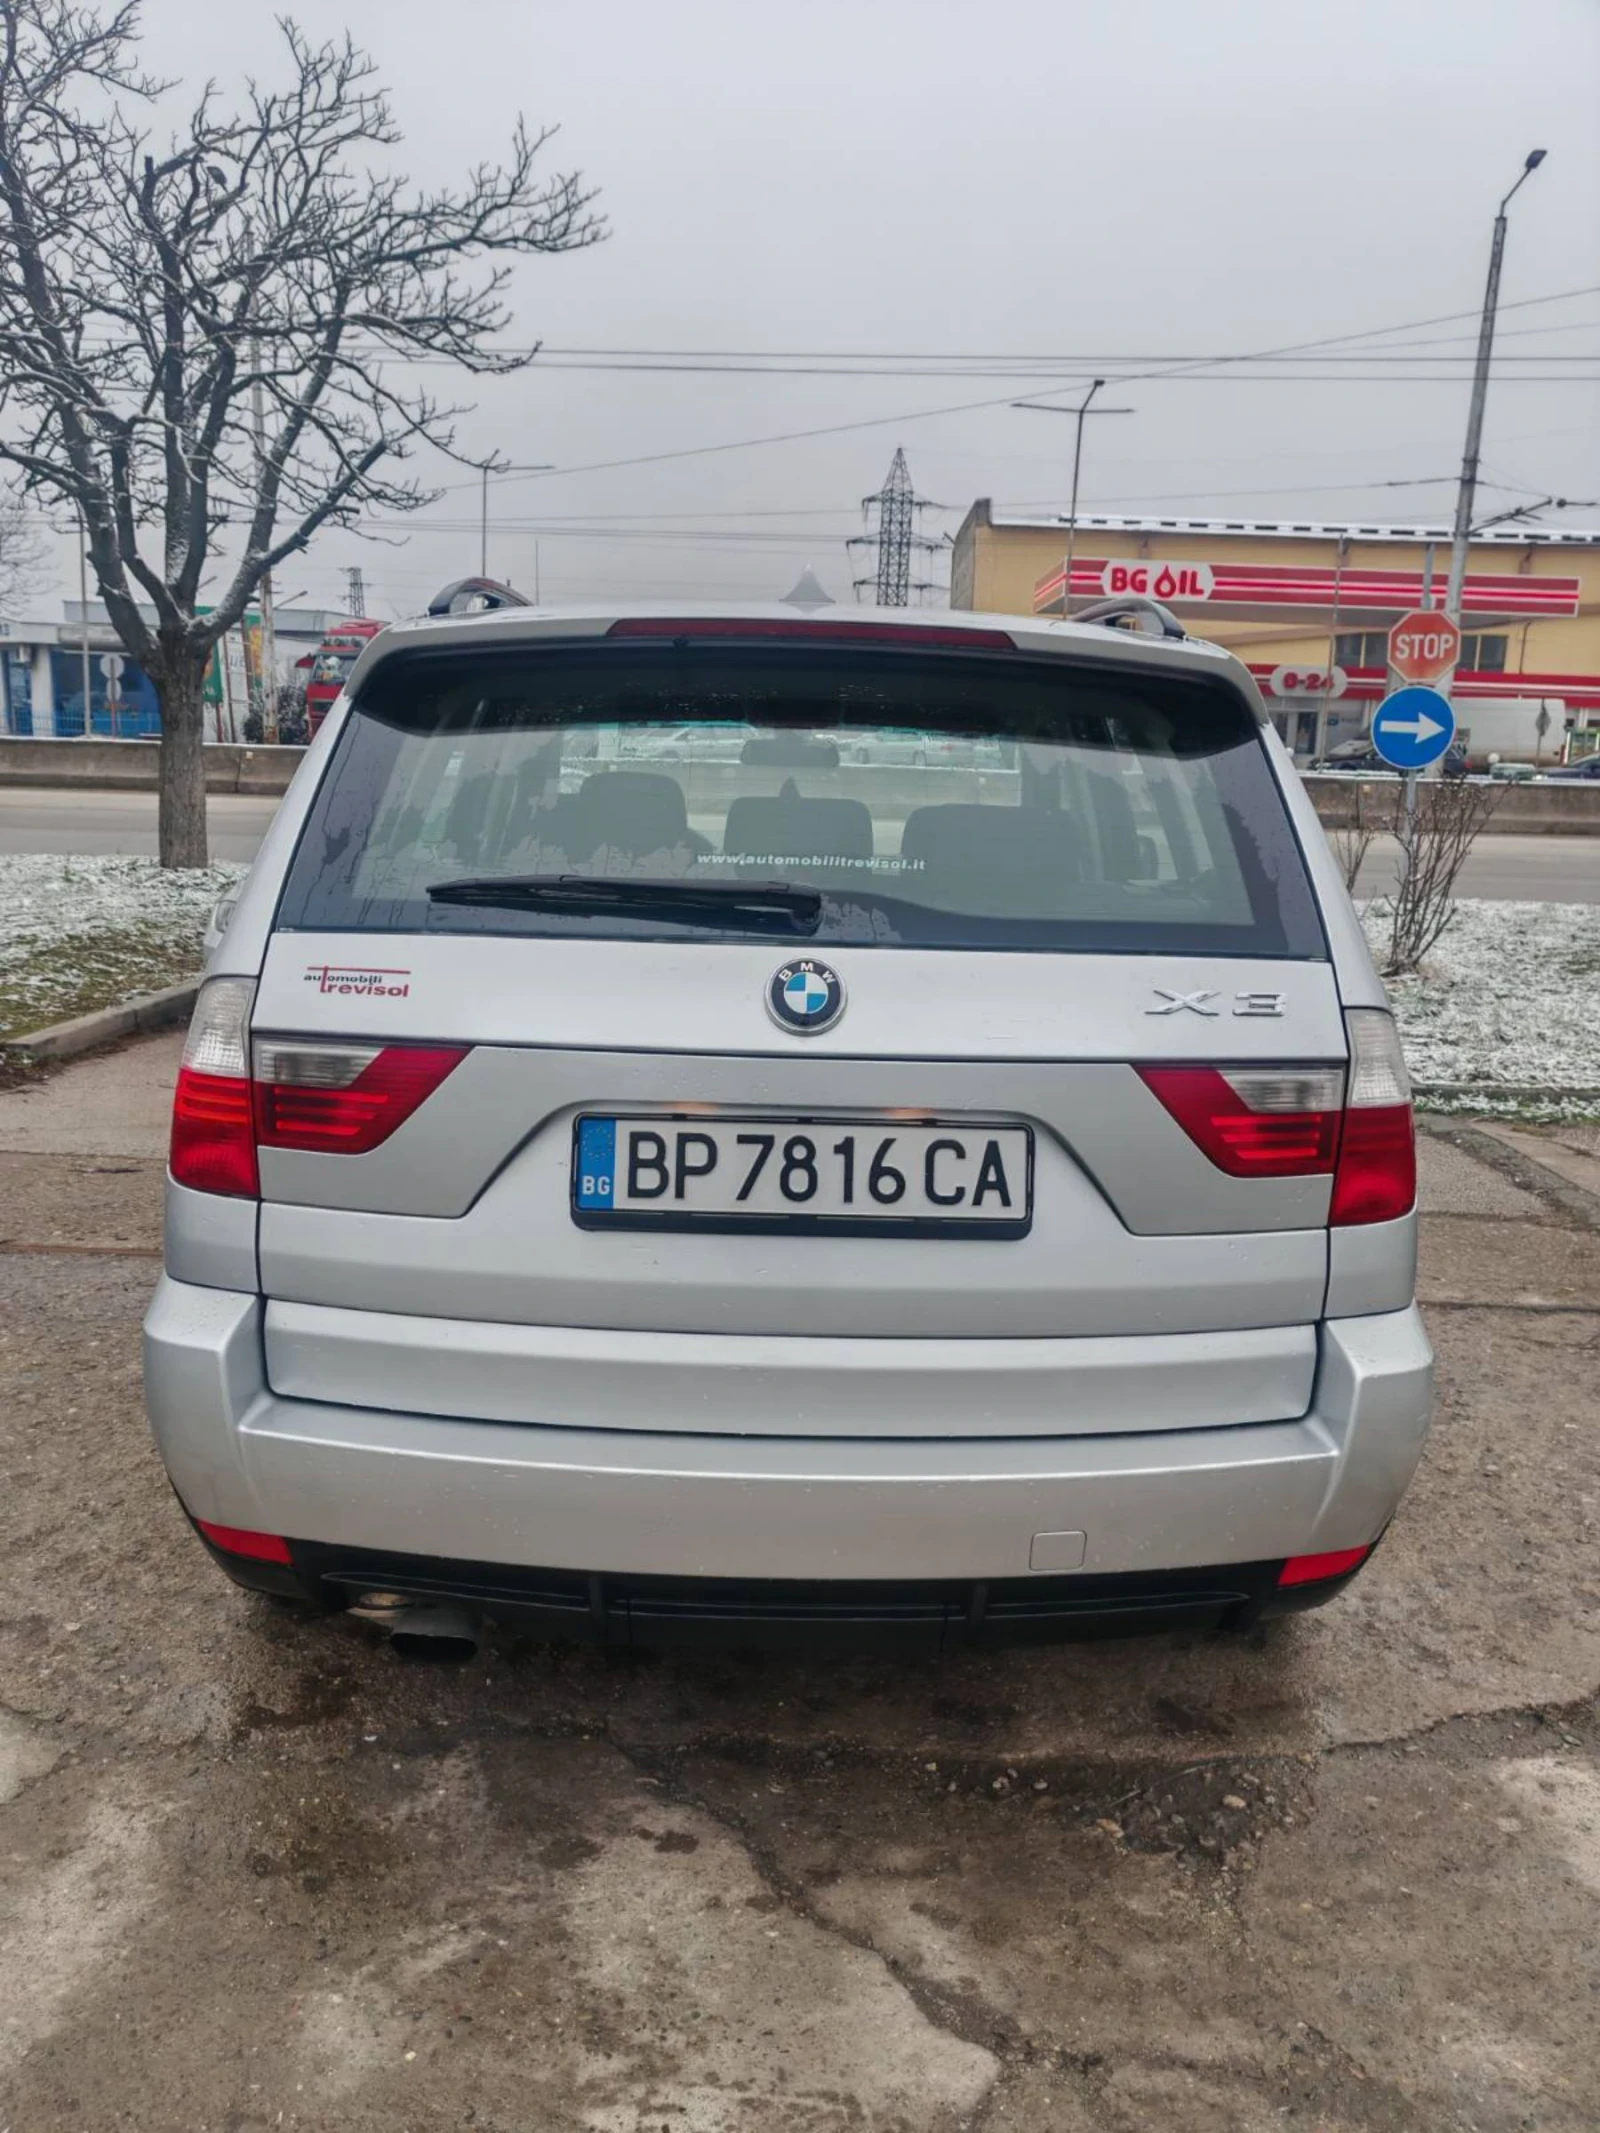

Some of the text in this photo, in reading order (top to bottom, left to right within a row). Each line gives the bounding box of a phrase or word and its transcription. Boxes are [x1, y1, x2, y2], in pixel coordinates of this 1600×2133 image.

[1111, 565, 1204, 598] BG OIL
[1395, 633, 1454, 660] STOP
[1283, 672, 1334, 690] 0-24
[697, 852, 926, 870] www.automobilitrevisol.it
[303, 974, 383, 985] automobili
[779, 962, 836, 983] BMW
[1145, 990, 1287, 1017] X3
[627, 1131, 1012, 1207] BP 7816 CA
[582, 1176, 610, 1195] BG
